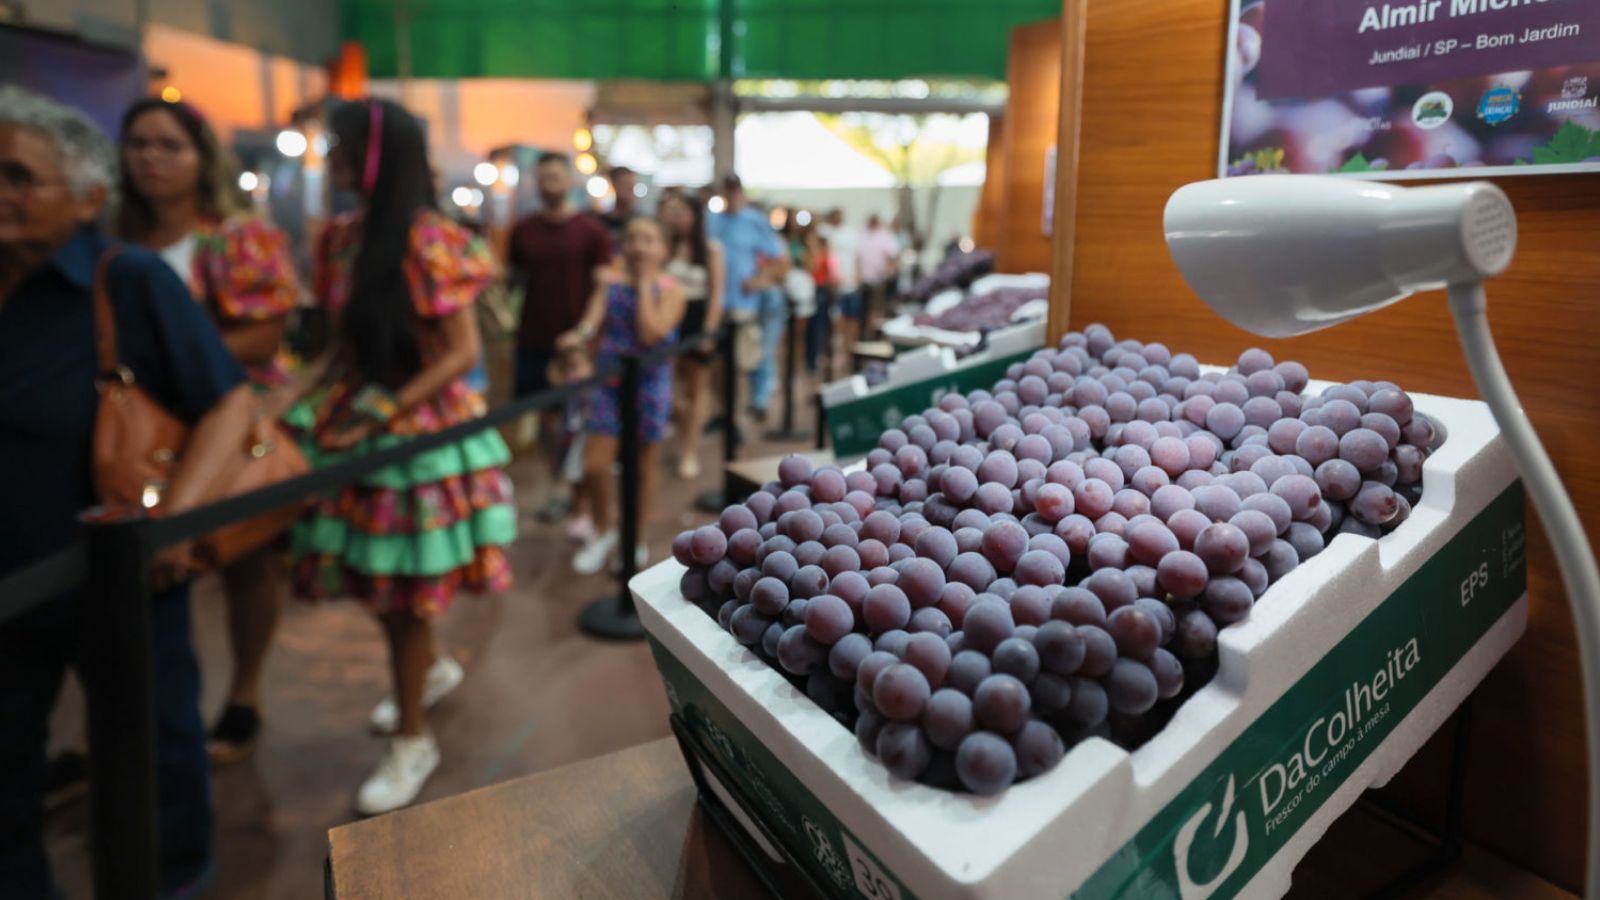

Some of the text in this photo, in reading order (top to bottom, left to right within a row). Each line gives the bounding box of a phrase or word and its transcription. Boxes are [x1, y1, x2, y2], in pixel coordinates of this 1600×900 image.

[1358, 0, 1441, 33] Almir
[1423, 42, 1431, 57] /
[1434, 39, 1458, 55] SP
[1475, 32, 1515, 50] Bom
[1519, 22, 1580, 44] Jardim
[1460, 562, 1489, 607] EPS
[1259, 637, 1421, 816] DaColheita
[1265, 702, 1390, 836] Frescor do campo à mesa
